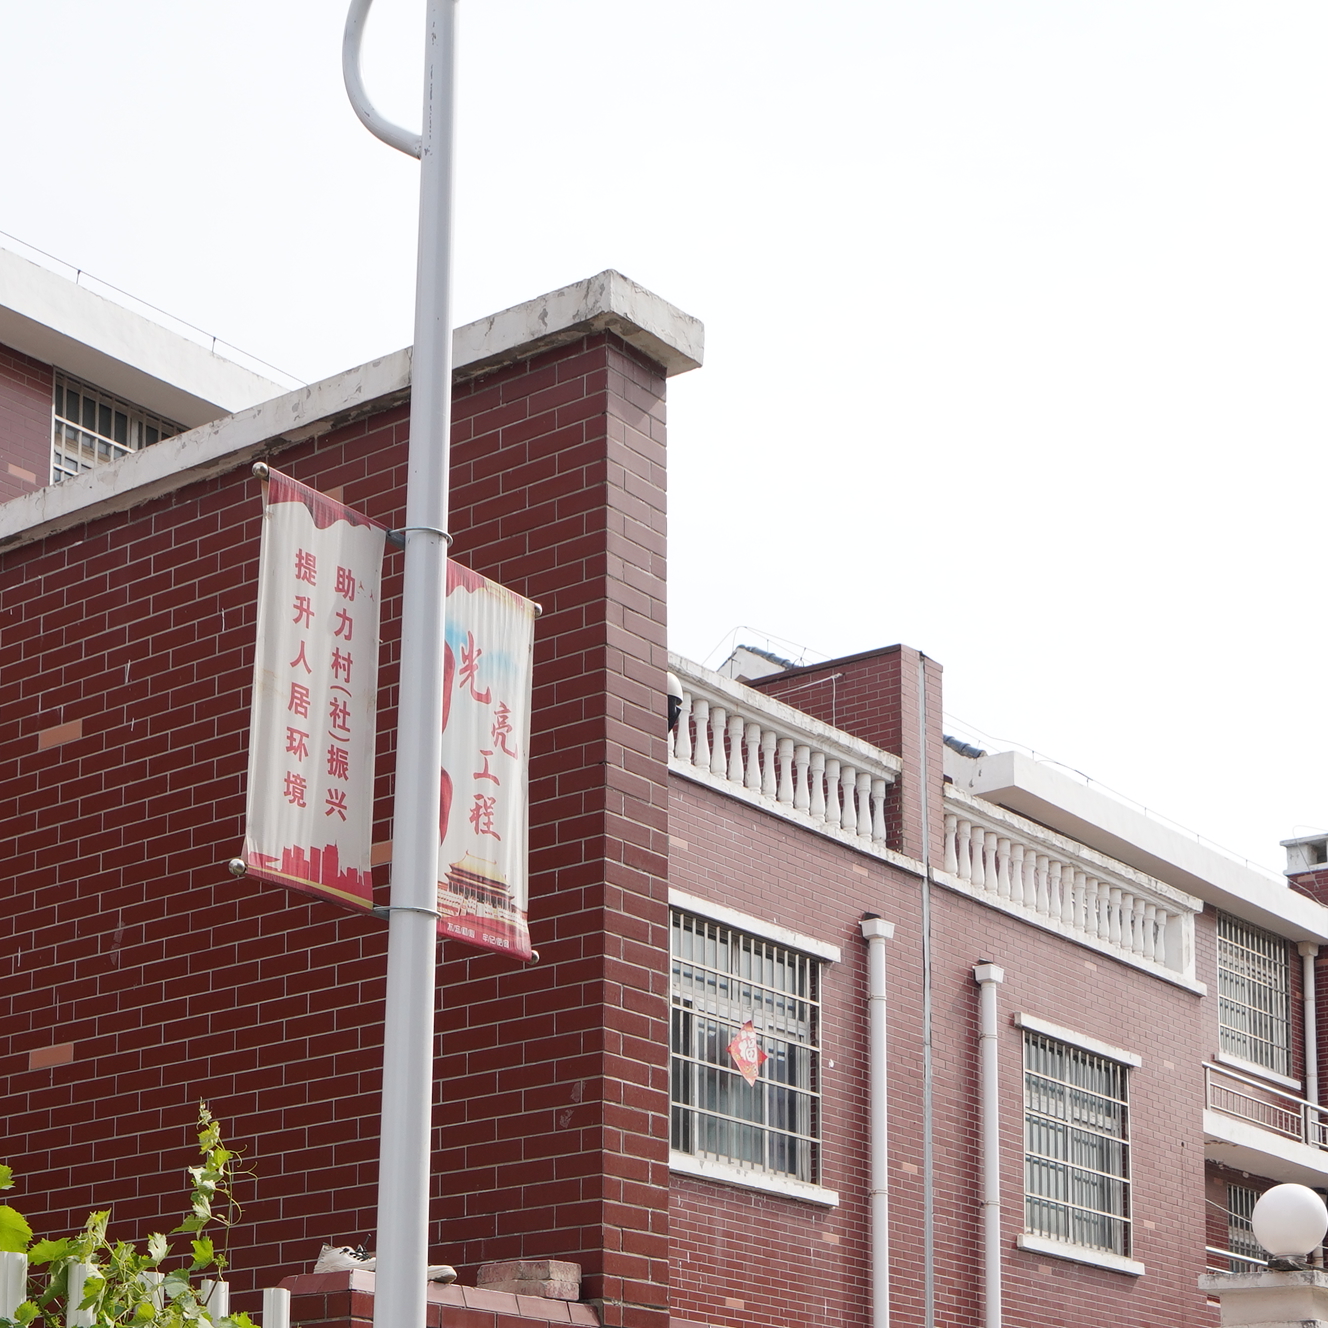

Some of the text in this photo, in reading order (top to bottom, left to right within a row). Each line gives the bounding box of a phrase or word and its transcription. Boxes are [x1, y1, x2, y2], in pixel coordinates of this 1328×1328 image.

[283, 548, 317, 808] 提升人居环境
[458, 631, 518, 841] 光亮工程
